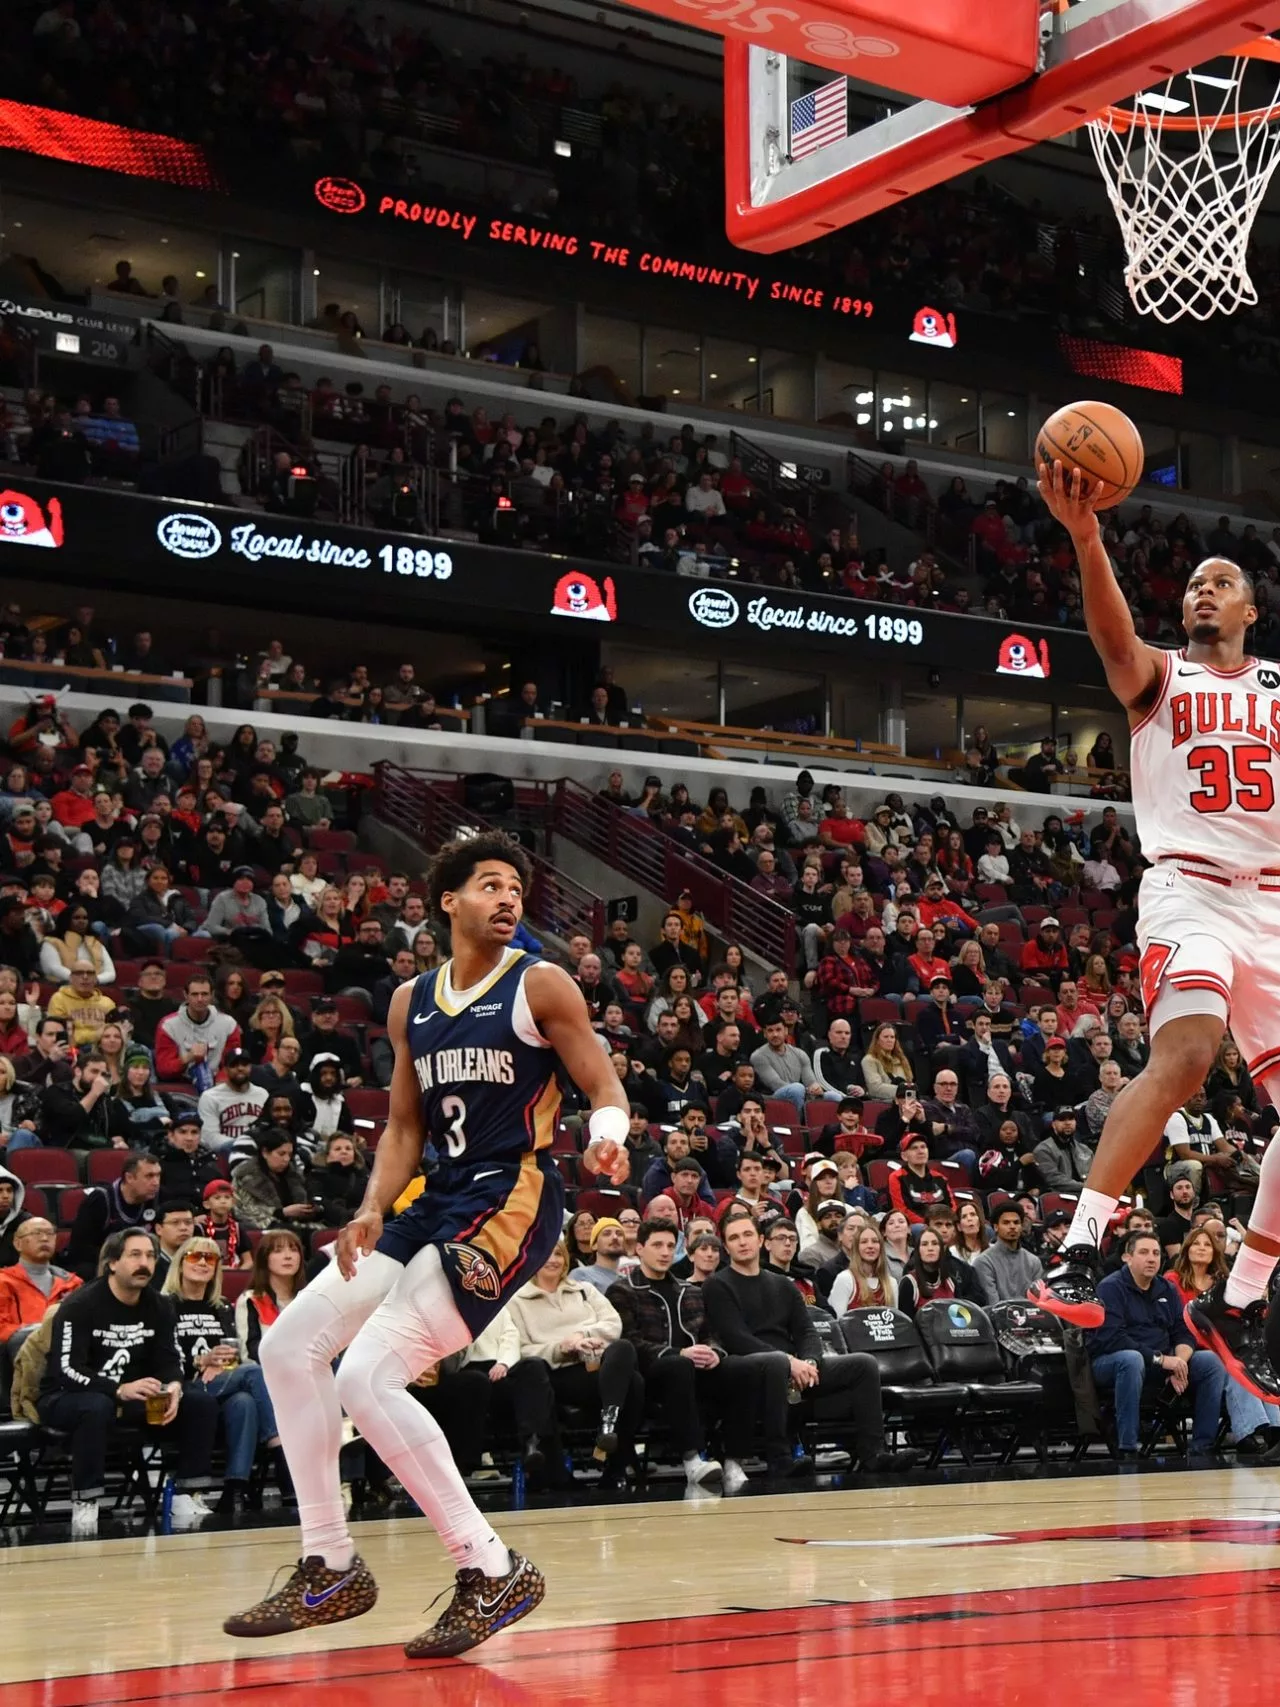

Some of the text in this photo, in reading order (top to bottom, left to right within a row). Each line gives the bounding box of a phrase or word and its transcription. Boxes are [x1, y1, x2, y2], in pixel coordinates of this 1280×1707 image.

[380, 197, 873, 317] PROUDLY SERVING THE COMMUNITY SINCE 1899
[16, 304, 74, 324] LEXUS
[231, 524, 453, 579] Local since 1899
[748, 597, 922, 645] Local since 1899
[1187, 745, 1275, 813] 35
[470, 1002, 503, 1014] NEWAGE
[436, 1047, 515, 1085] ORLEANS
[219, 1102, 264, 1124] CHICAG
[441, 1095, 466, 1158] 3
[62, 1321, 72, 1353] HEART
